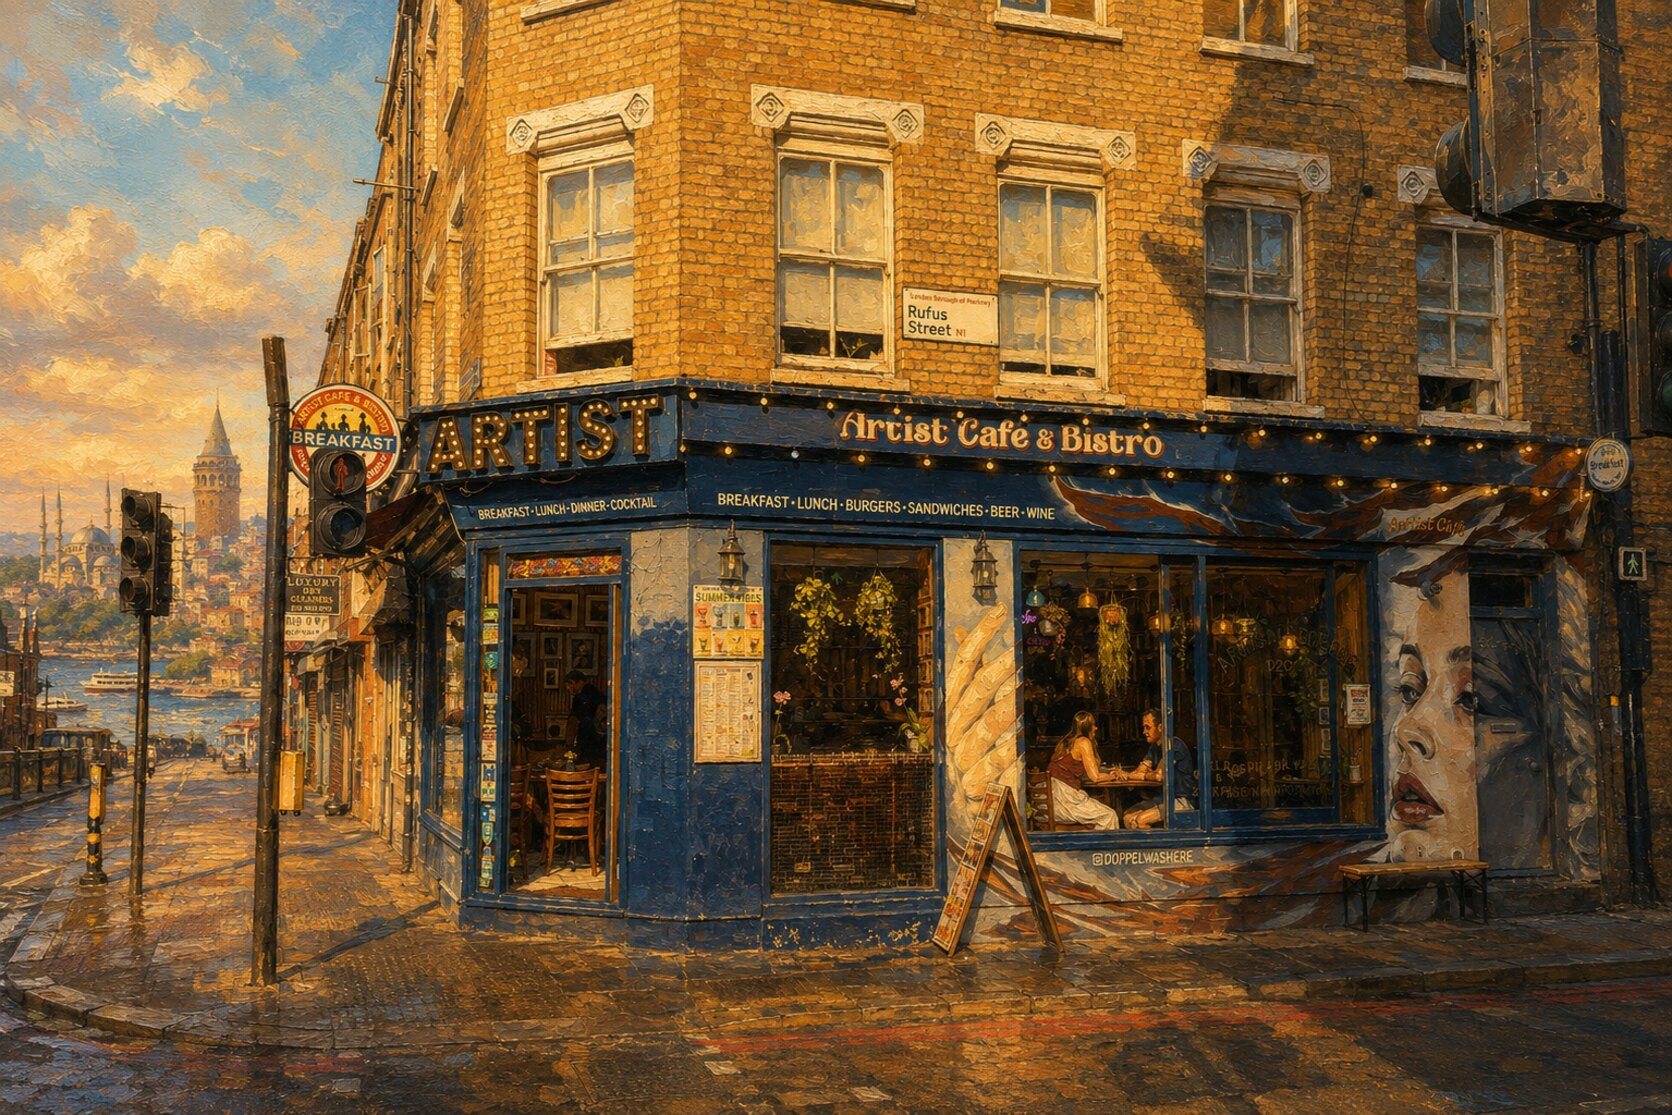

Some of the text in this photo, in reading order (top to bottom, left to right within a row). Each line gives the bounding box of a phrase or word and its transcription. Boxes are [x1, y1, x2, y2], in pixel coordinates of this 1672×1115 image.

[908, 305, 948, 320] Rufus
[908, 320, 952, 336] Street
[292, 431, 394, 451] BREAKFAST
[425, 393, 664, 474] ARTIST
[839, 409, 951, 447] Artist
[1036, 427, 1055, 451] &
[1060, 423, 1165, 457] Bistro
[478, 497, 657, 520] BREAKFAST LUNCH DINNER COCKTAIL
[717, 493, 1055, 520] BREAKFAST LUNCH BURGERS SANDWICHES BEER WINE
